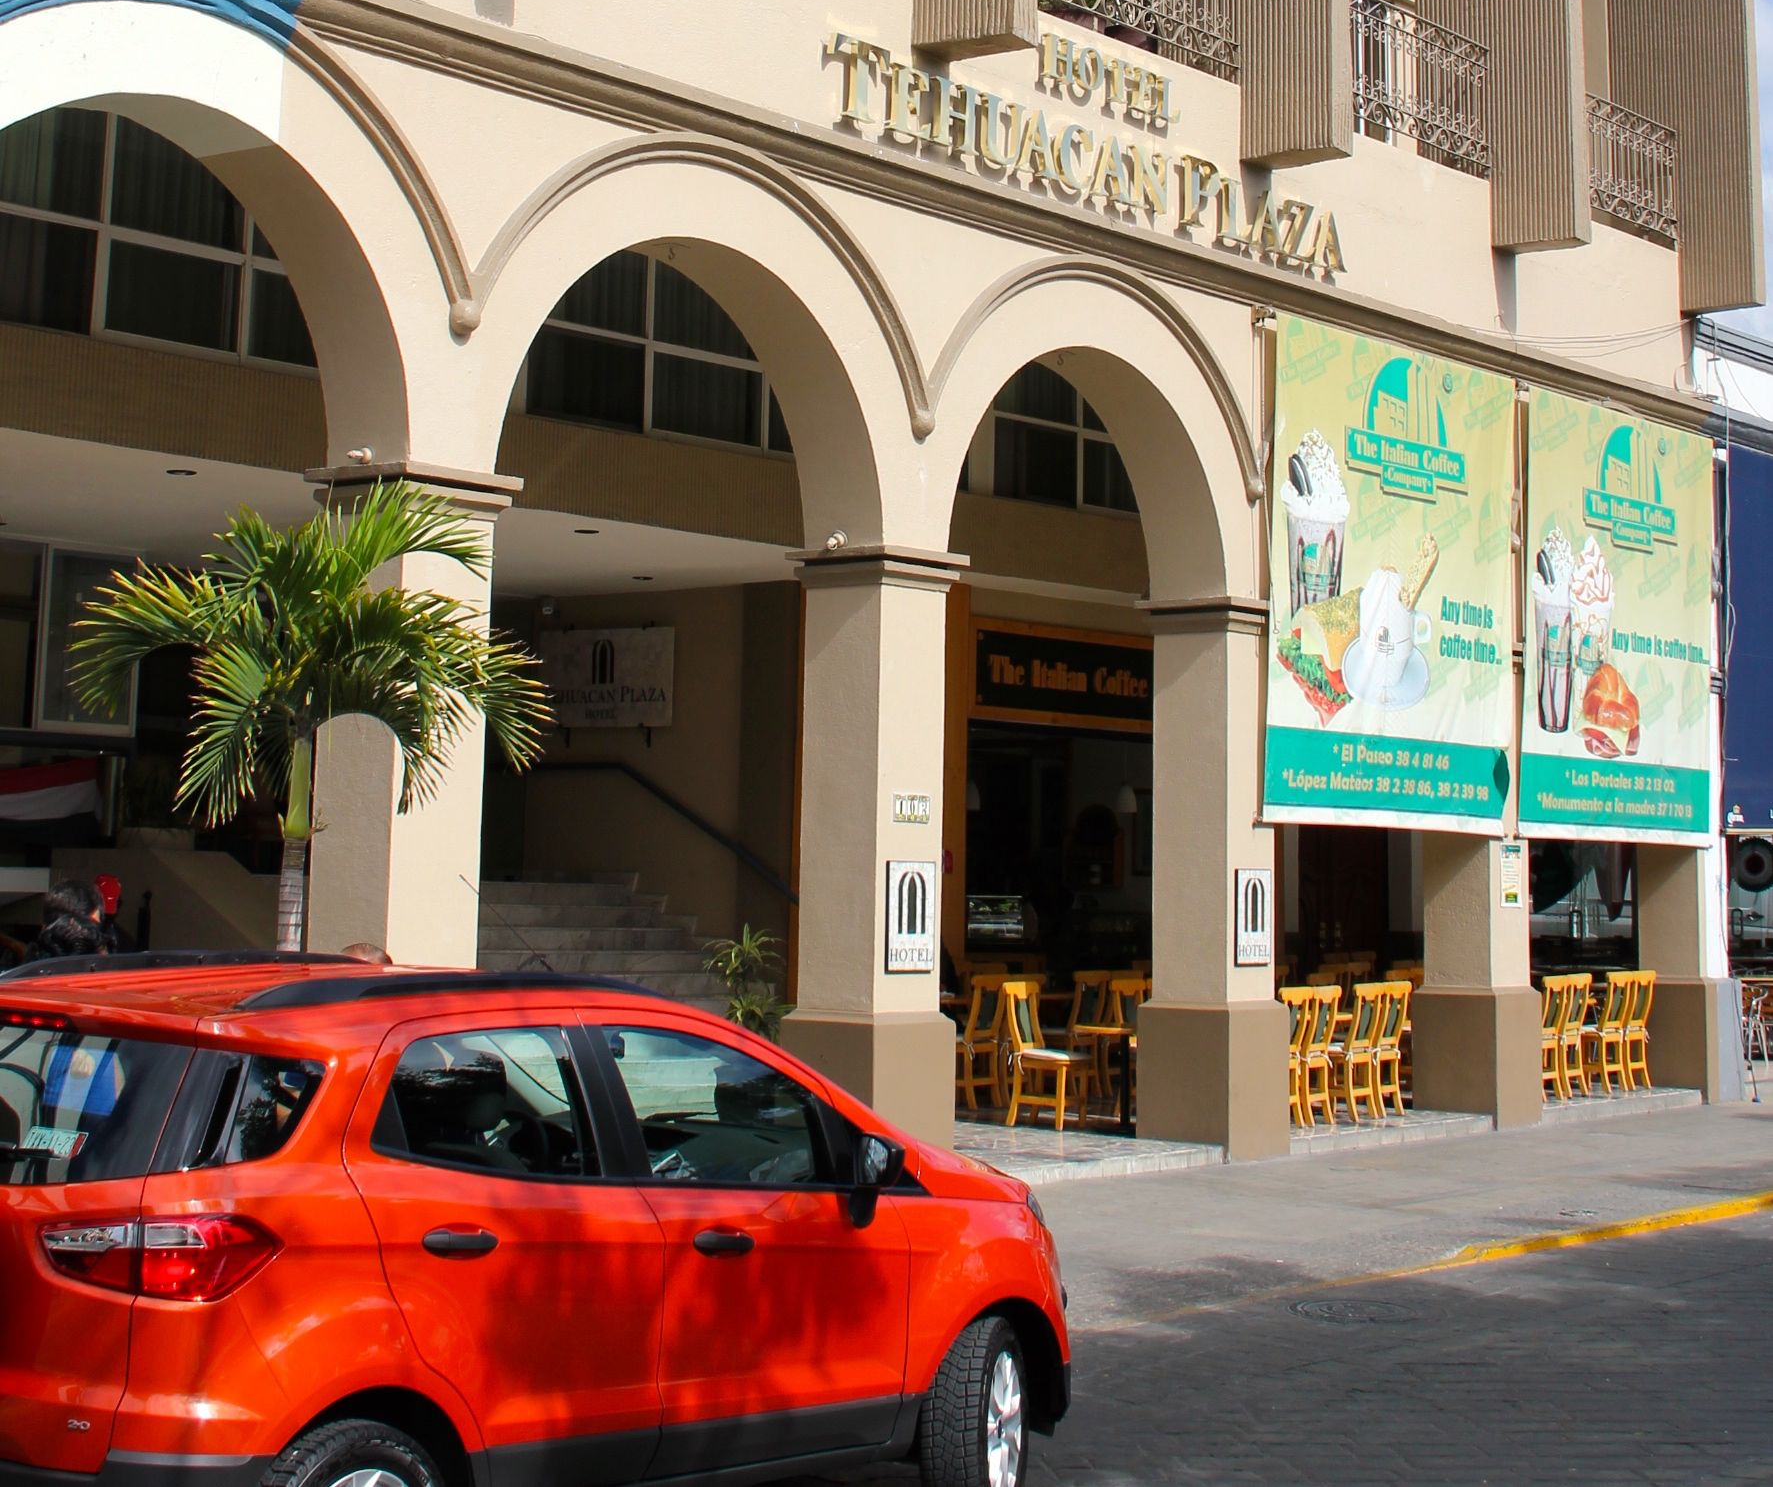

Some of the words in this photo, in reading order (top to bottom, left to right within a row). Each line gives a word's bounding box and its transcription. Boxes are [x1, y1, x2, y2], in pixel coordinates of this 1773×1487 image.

[1041, 31, 1181, 124] HOTEL
[826, 31, 1172, 216] TEHUACAN
[1180, 154, 1348, 274] PLAZA
[1354, 433, 1379, 459] The
[1381, 440, 1419, 468] Italian
[1422, 450, 1460, 476] Coffee
[1386, 467, 1428, 493] Company
[1590, 493, 1609, 515] The
[1611, 498, 1641, 522] Italian
[1643, 506, 1672, 530] Coffee
[1440, 596, 1461, 625] Any
[1462, 600, 1482, 627] time
[1440, 634, 1472, 660] coffee
[1611, 628, 1629, 653] Any
[1631, 631, 1652, 655] time
[1664, 638, 1686, 661] coffee
[989, 654, 1025, 686] The
[1031, 659, 1088, 692] Italian
[1094, 667, 1149, 698] Coffee
[620, 685, 667, 703] PLAZA
[1341, 743, 1353, 762] El
[1357, 745, 1393, 765] Paseo
[1395, 750, 1409, 766] 38
[1412, 752, 1419, 768] 4
[1435, 754, 1450, 770] 46
[1286, 765, 1327, 791] López
[1330, 772, 1373, 792] Mateos
[1375, 777, 1390, 793] 38
[1392, 777, 1400, 794] 2
[1437, 782, 1450, 798] 38
[1452, 783, 1459, 798] 2
[1461, 784, 1475, 799] 39
[1571, 770, 1589, 786] Los
[1592, 770, 1632, 790] Portales
[1541, 792, 1603, 813] Monumento
[1605, 800, 1612, 813] a
[1614, 797, 1624, 814] la
[1626, 799, 1655, 815] madre
[890, 947, 933, 963] HOTEL
[1238, 944, 1270, 957] HOTEL
